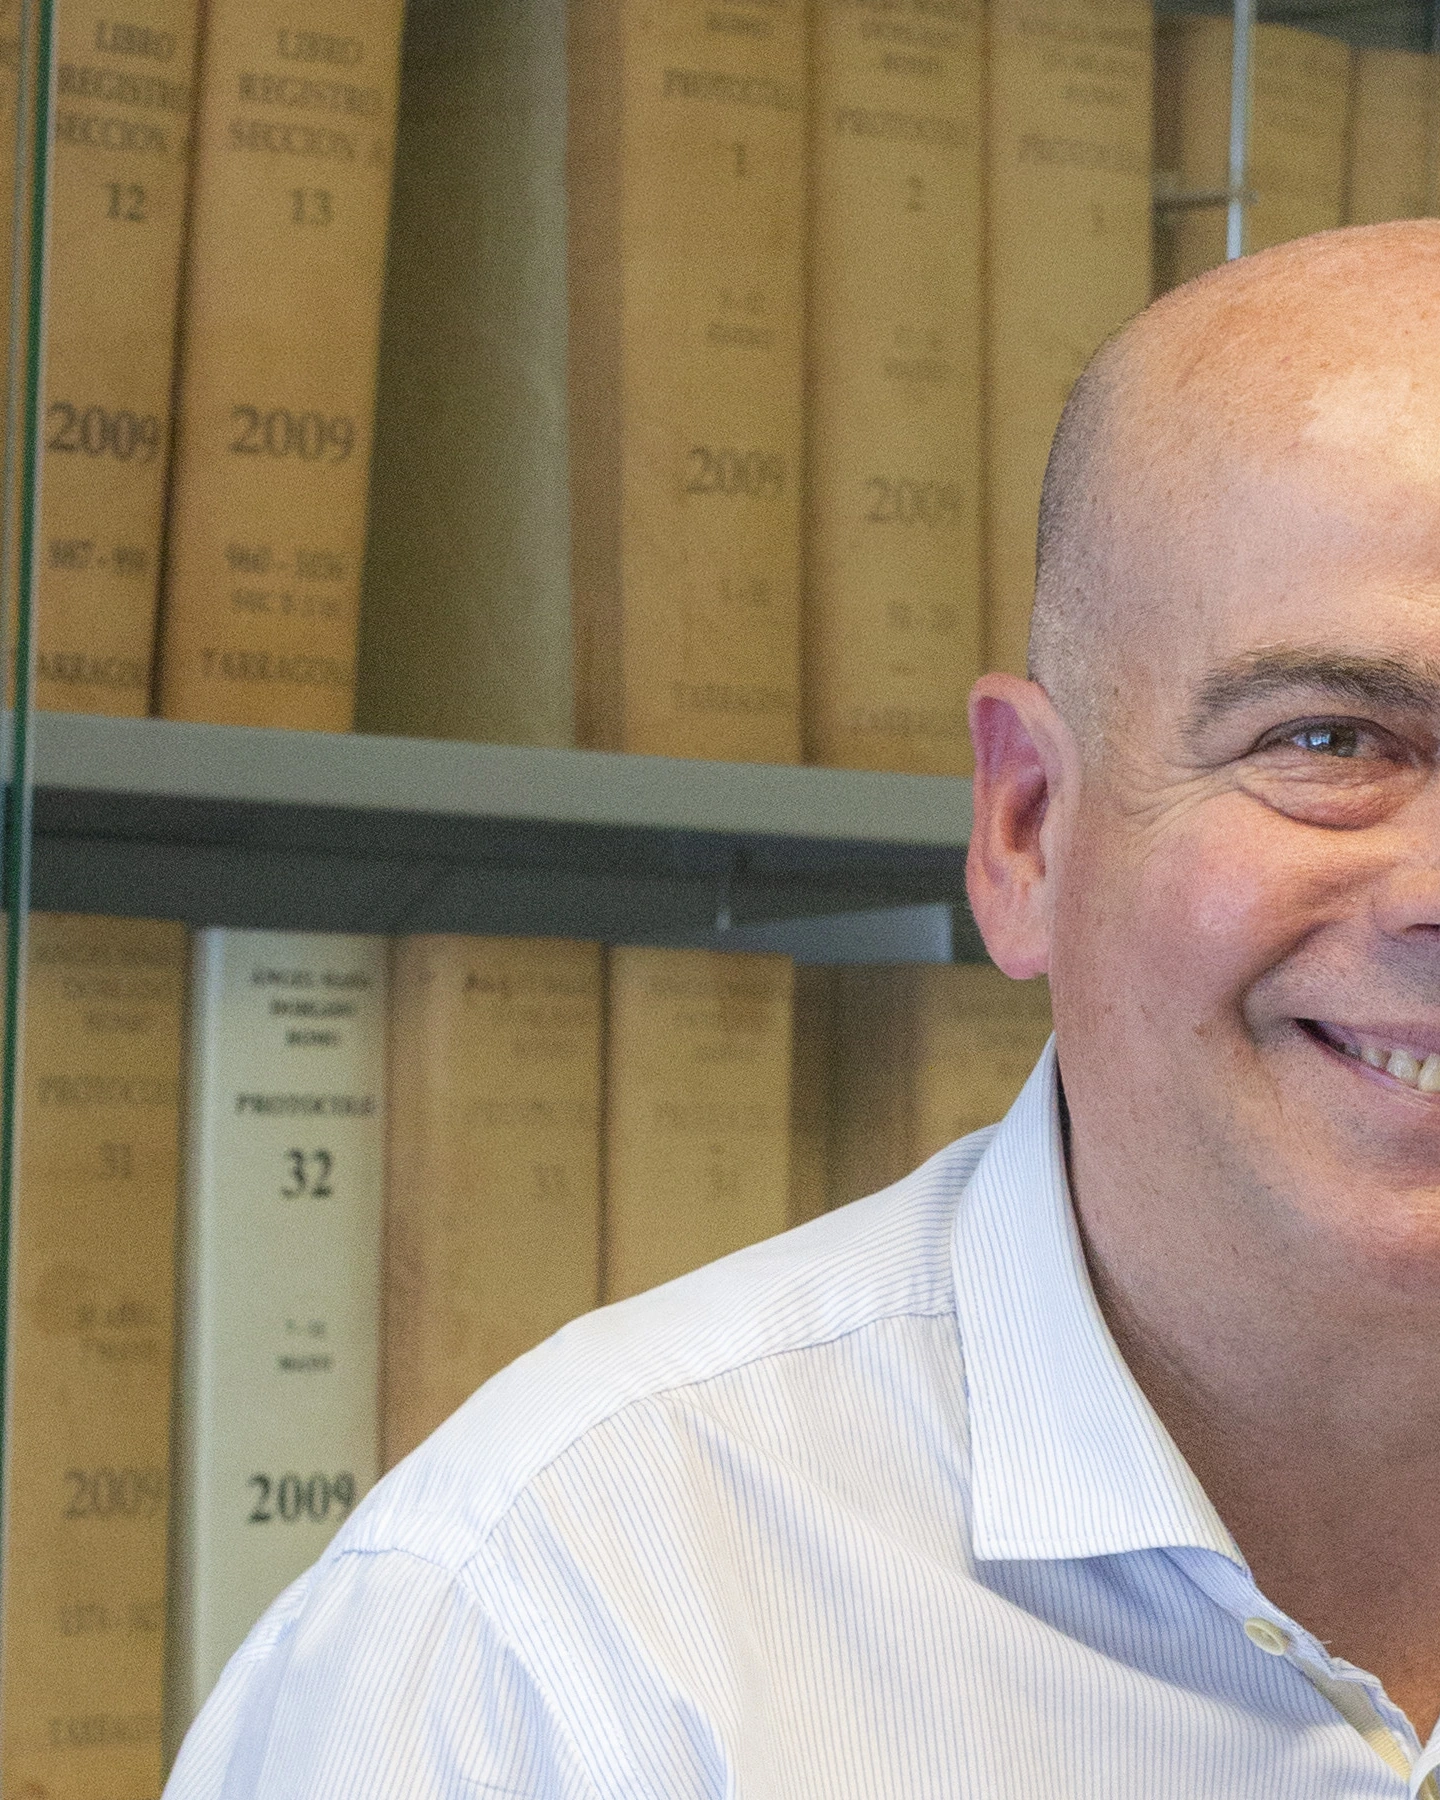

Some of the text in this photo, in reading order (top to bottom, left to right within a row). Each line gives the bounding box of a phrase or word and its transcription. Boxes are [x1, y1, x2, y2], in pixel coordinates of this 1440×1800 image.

[97, 21, 177, 63] LIBRO
[277, 27, 364, 66] LIBRO
[239, 72, 383, 116] REGISTRO
[105, 183, 146, 224] 12
[289, 188, 334, 226] 13
[47, 402, 161, 464] 2009
[228, 405, 356, 465] 2009
[686, 446, 786, 498] 2009
[865, 476, 963, 528] 2009
[280, 1147, 334, 1200] 32
[63, 1467, 165, 1521] 2009
[246, 1471, 359, 1524] 2009
